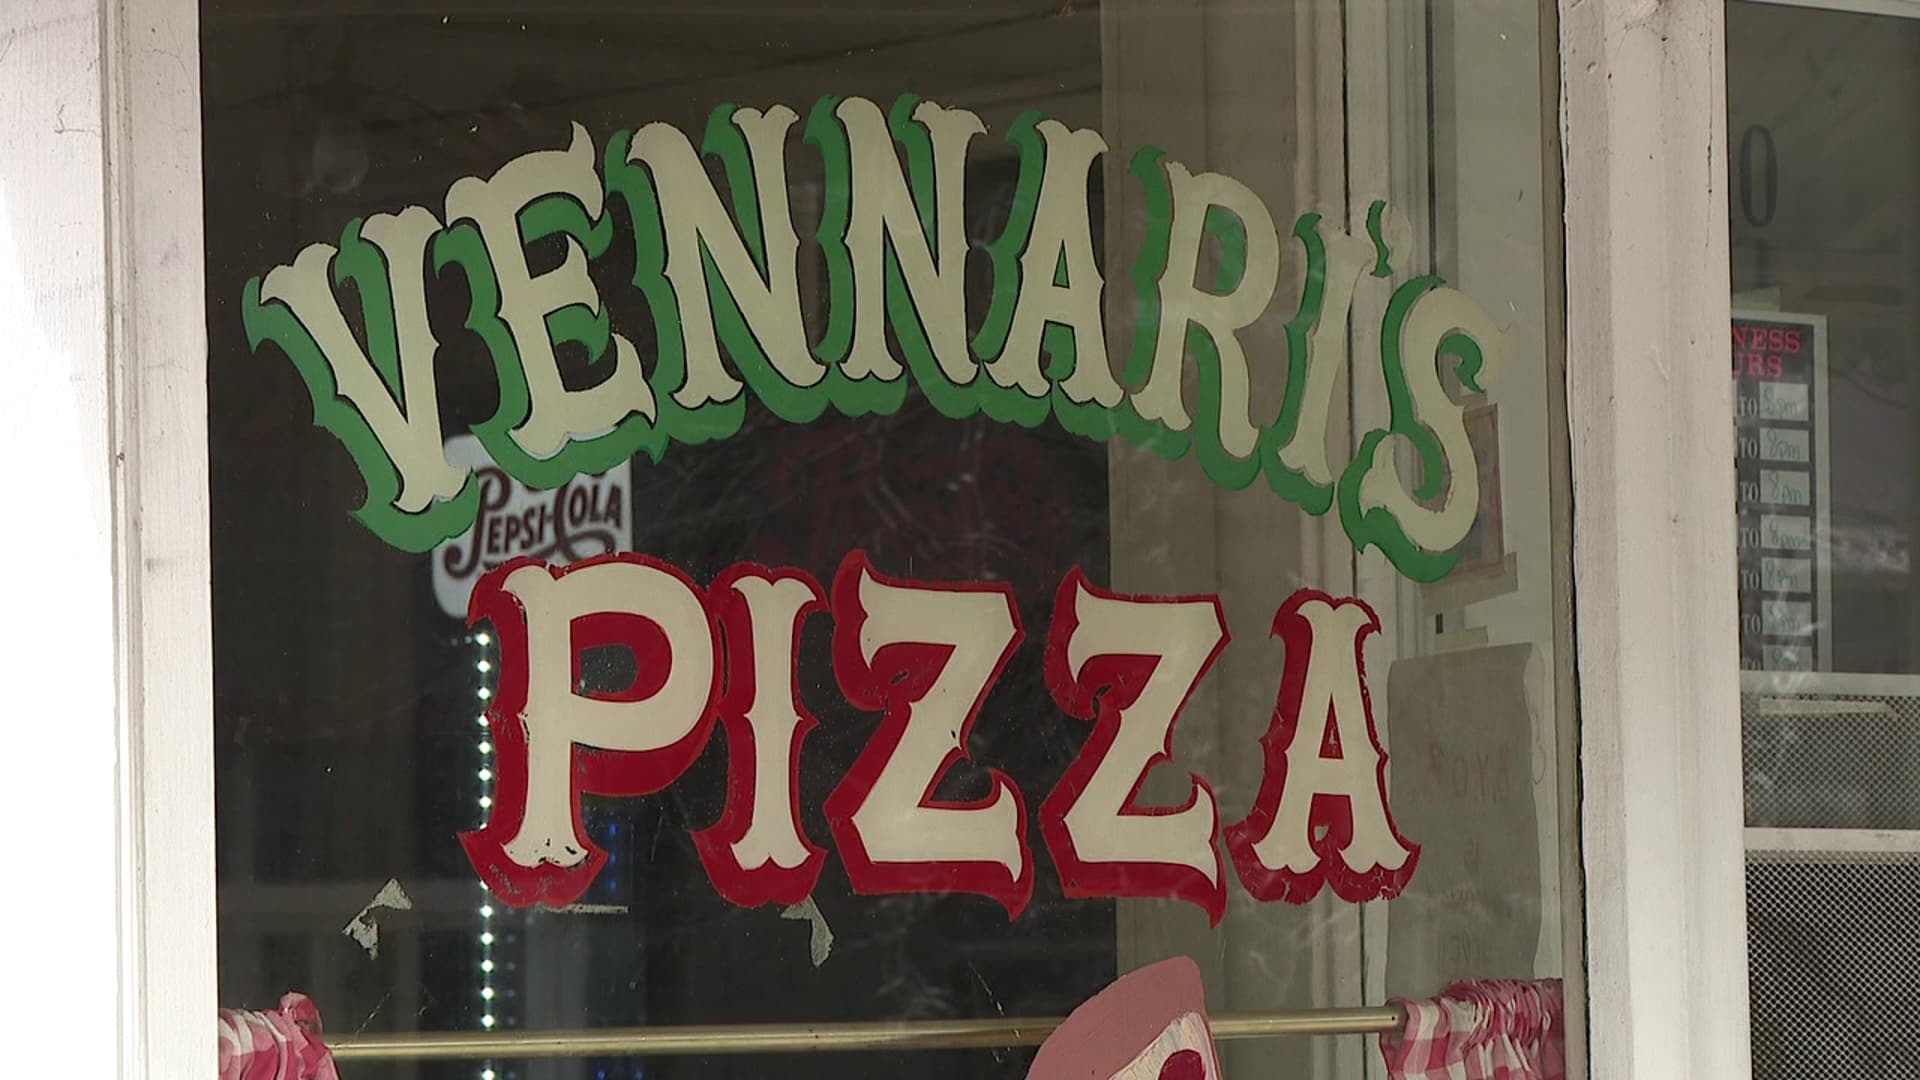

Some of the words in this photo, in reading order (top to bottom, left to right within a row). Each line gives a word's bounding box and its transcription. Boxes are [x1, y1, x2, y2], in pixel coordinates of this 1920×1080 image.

[244, 95, 1514, 583] VENNARI'S
[1739, 396, 1759, 417] TO
[1739, 438, 1759, 460] TO
[1739, 481, 1760, 503] TO
[1740, 528, 1760, 549] TO
[1741, 570, 1761, 591] TO
[458, 550, 1421, 928] PIZZA
